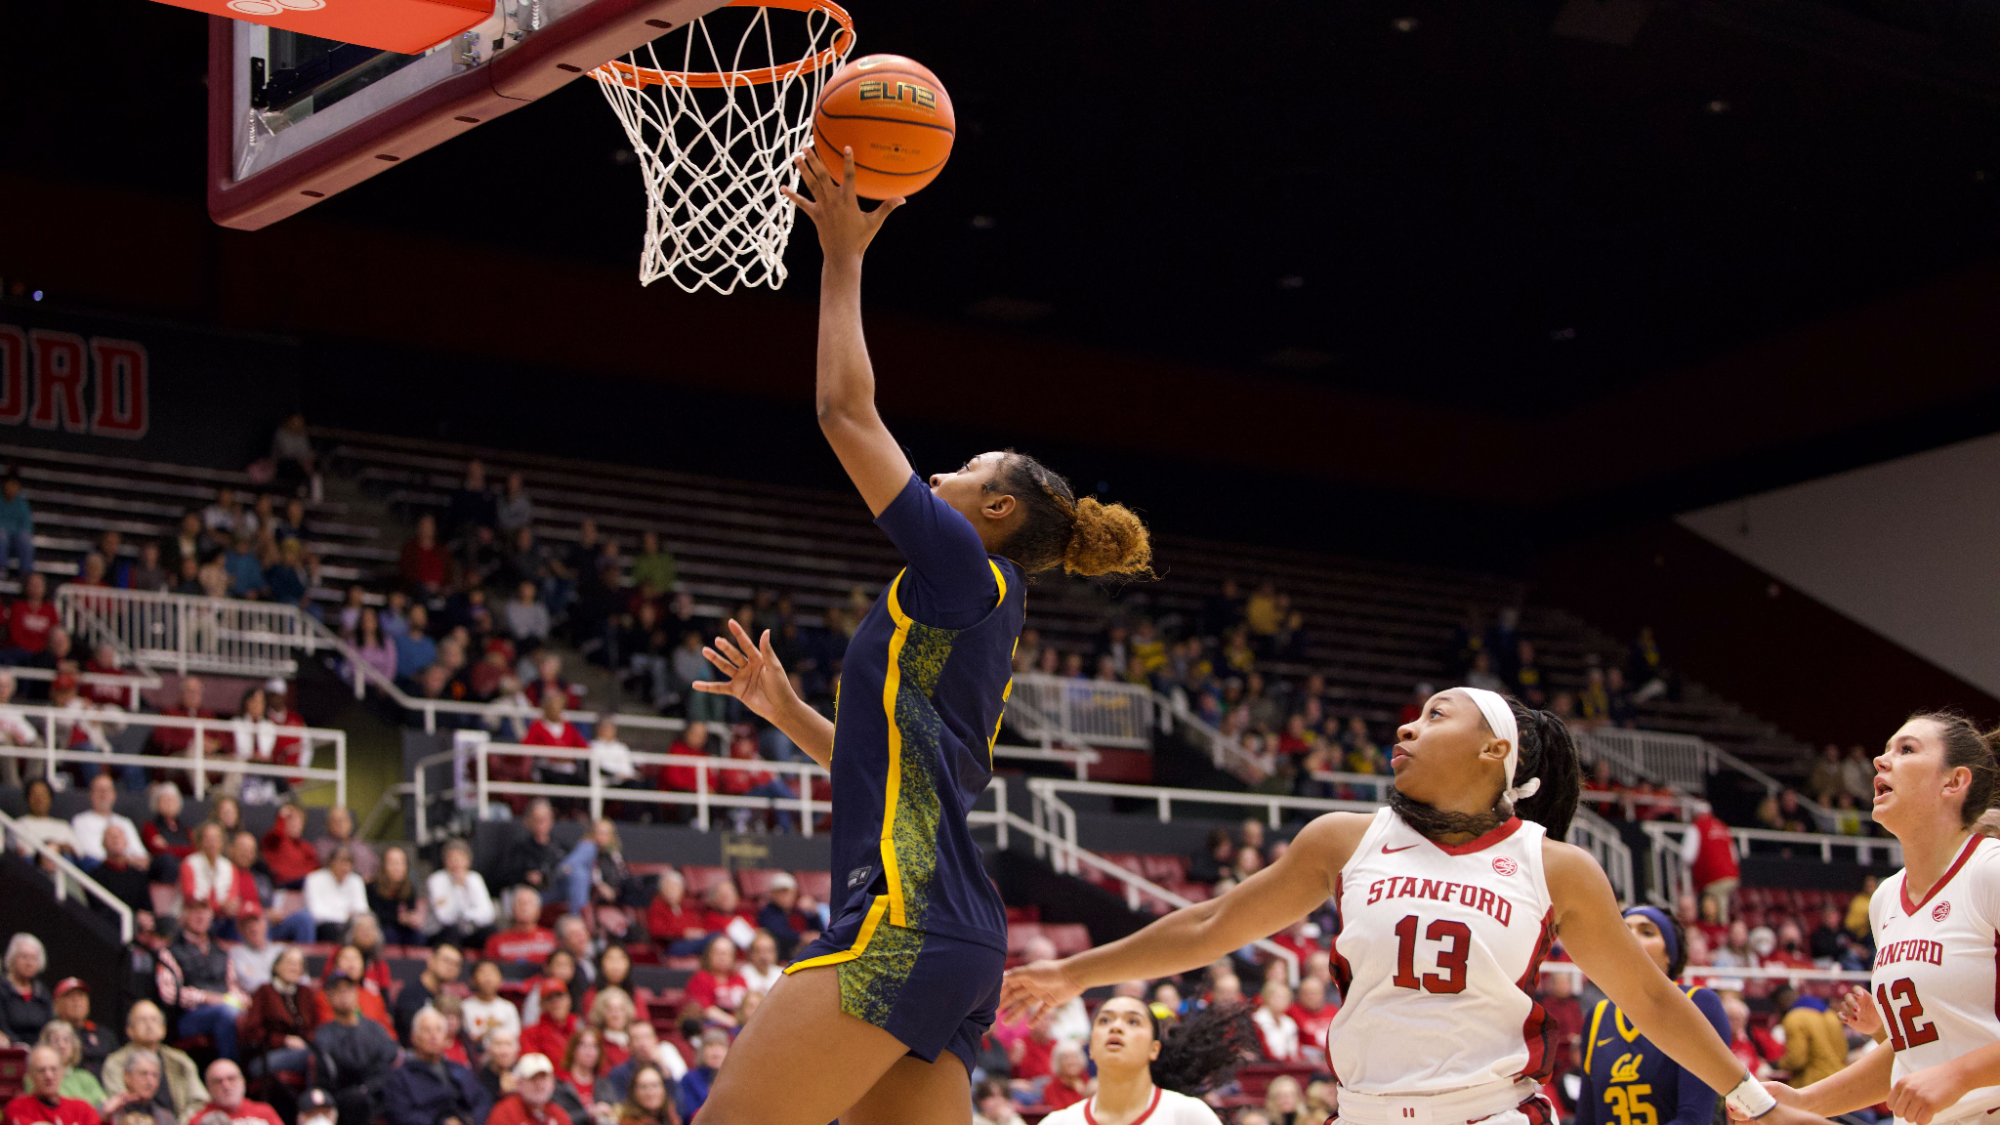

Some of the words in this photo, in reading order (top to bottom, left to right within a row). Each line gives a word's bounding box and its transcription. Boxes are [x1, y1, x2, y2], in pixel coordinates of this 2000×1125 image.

[859, 80, 936, 110] ELITE
[1367, 876, 1512, 928] STANFORD
[1392, 914, 1472, 994] 13
[1876, 977, 1940, 1053] 12
[1609, 1053, 1644, 1083] Cal
[1603, 1083, 1659, 1125] 35
